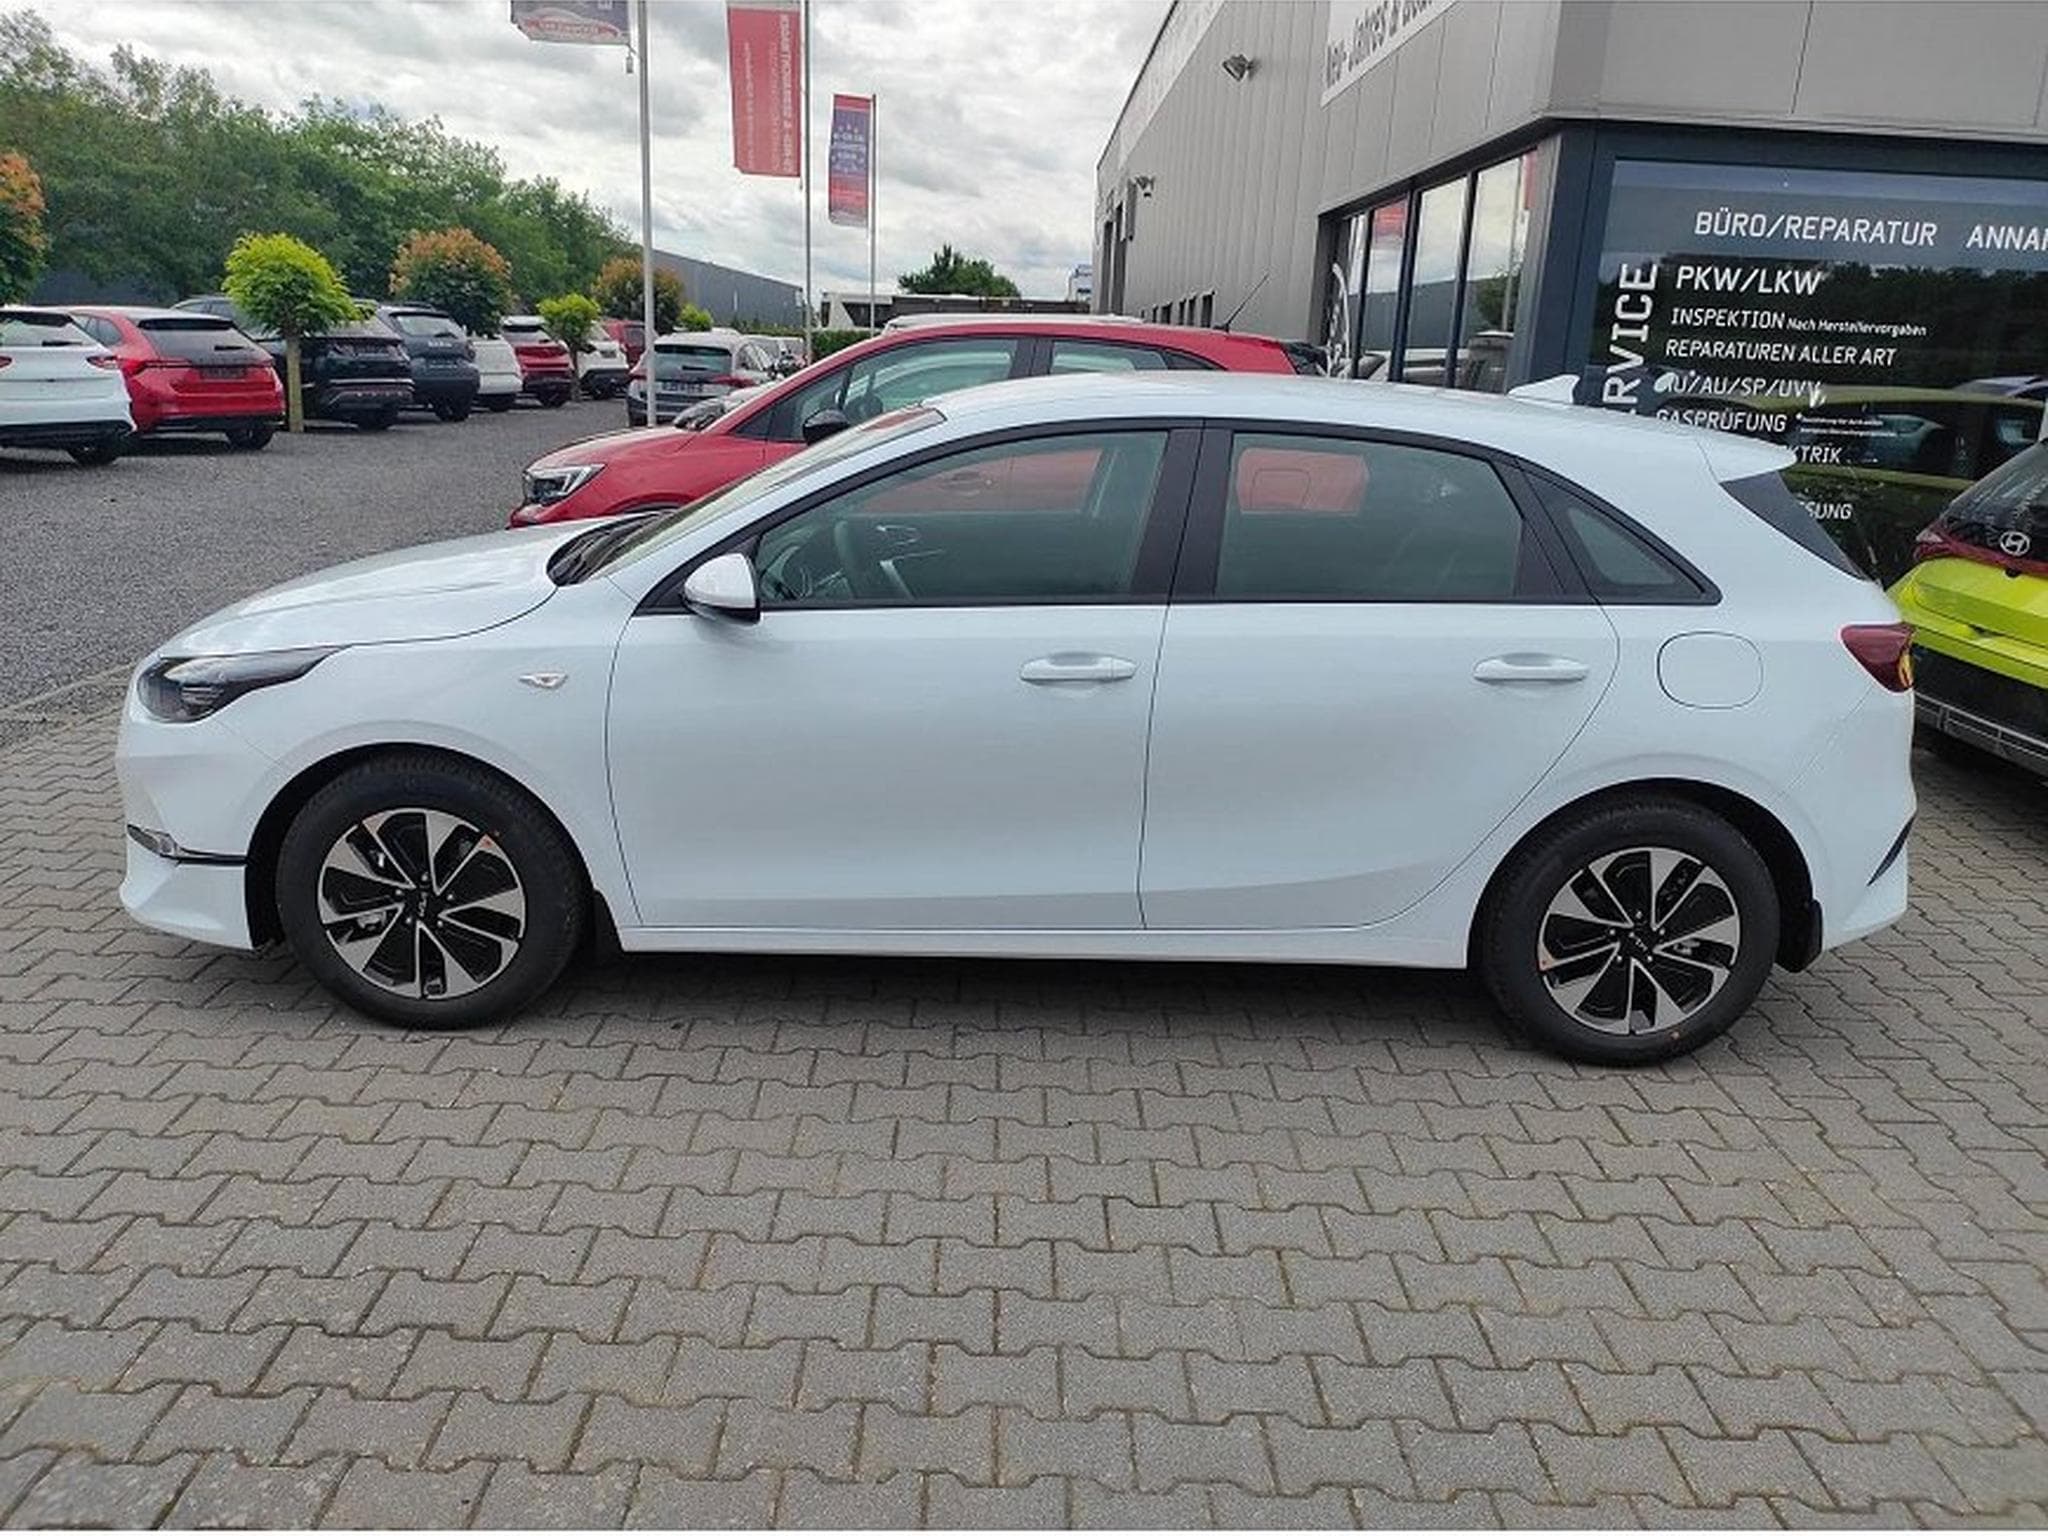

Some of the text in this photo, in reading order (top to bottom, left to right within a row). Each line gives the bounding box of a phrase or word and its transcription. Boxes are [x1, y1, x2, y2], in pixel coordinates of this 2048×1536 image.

[1695, 207, 1938, 247] BÜRO/REPARATUR
[1676, 265, 1821, 296] PKW/LKW
[1671, 307, 1785, 330] INSPEKTION
[1787, 317, 1817, 332] Nach
[1602, 263, 1658, 414] RVICE
[1666, 339, 1897, 366] REPARATUREN ALLER ART
